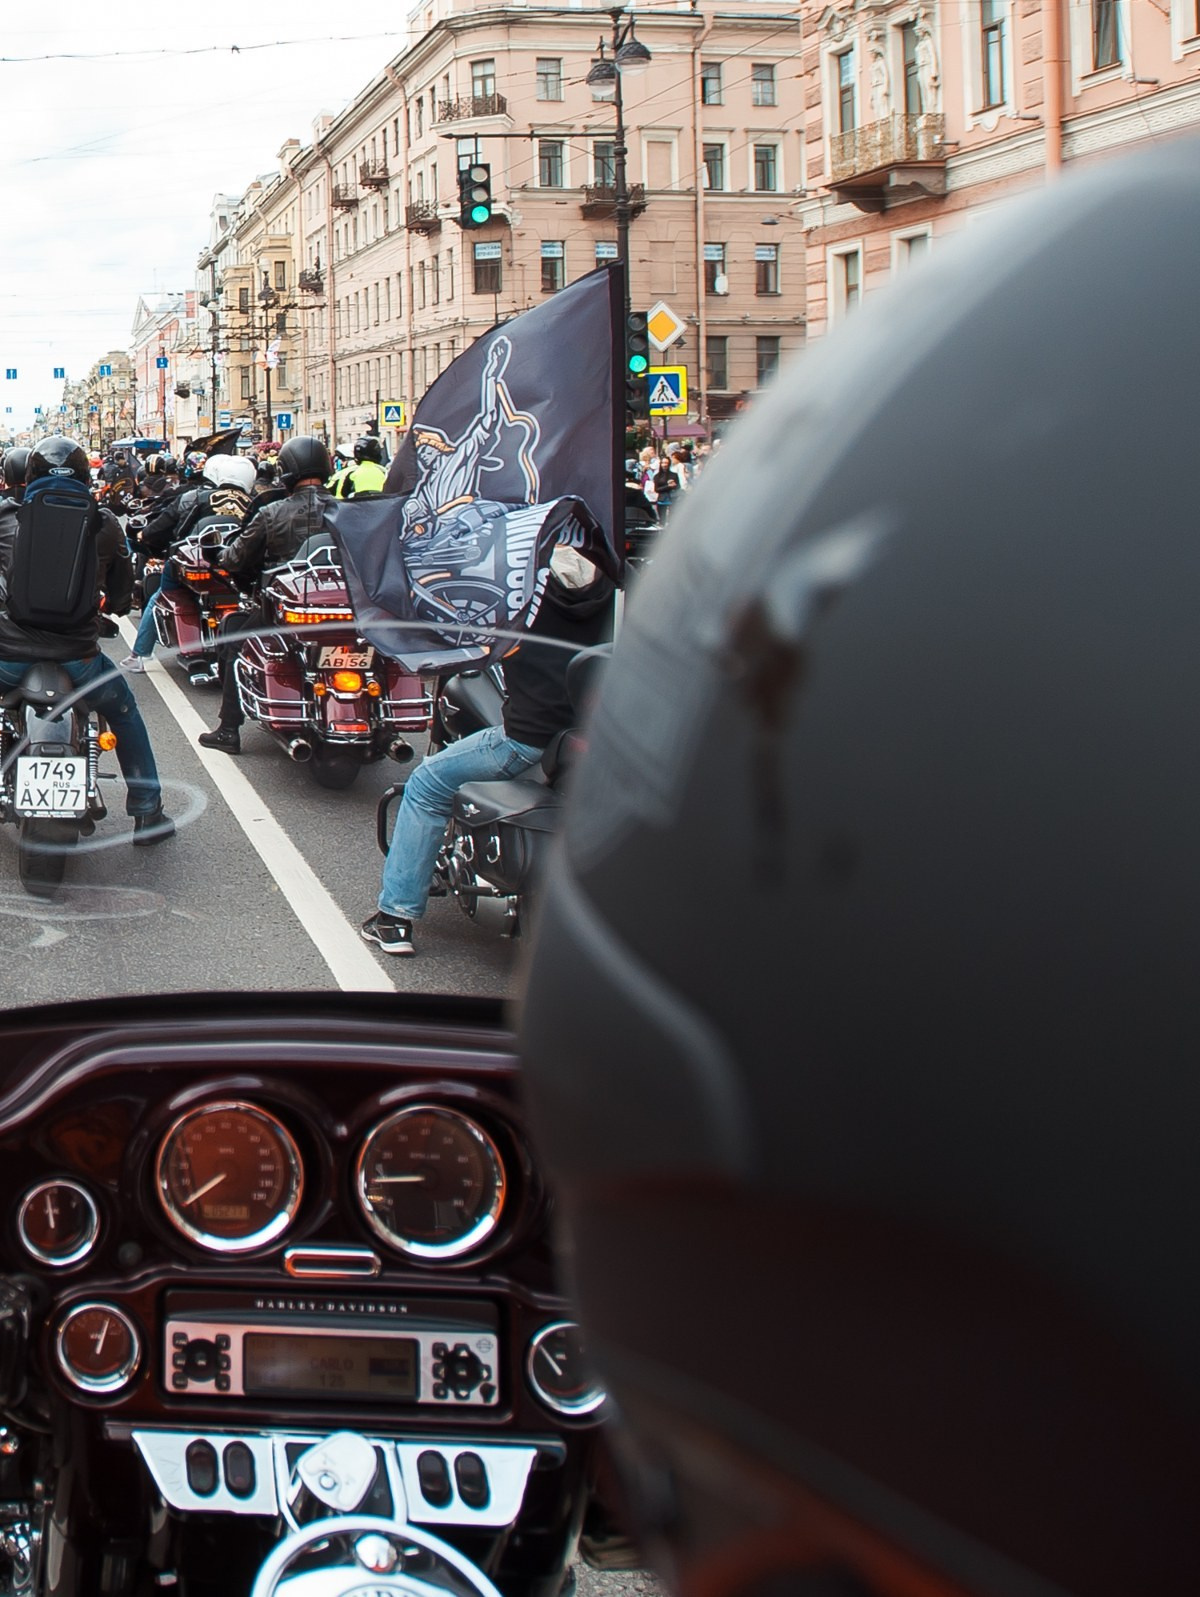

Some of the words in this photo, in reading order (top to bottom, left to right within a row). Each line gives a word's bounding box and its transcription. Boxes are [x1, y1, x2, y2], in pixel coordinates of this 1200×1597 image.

[29, 762, 76, 780] 1749
[58, 789, 81, 807] 77
[256, 1299, 408, 1313] HARLEY-DAVIDSON
